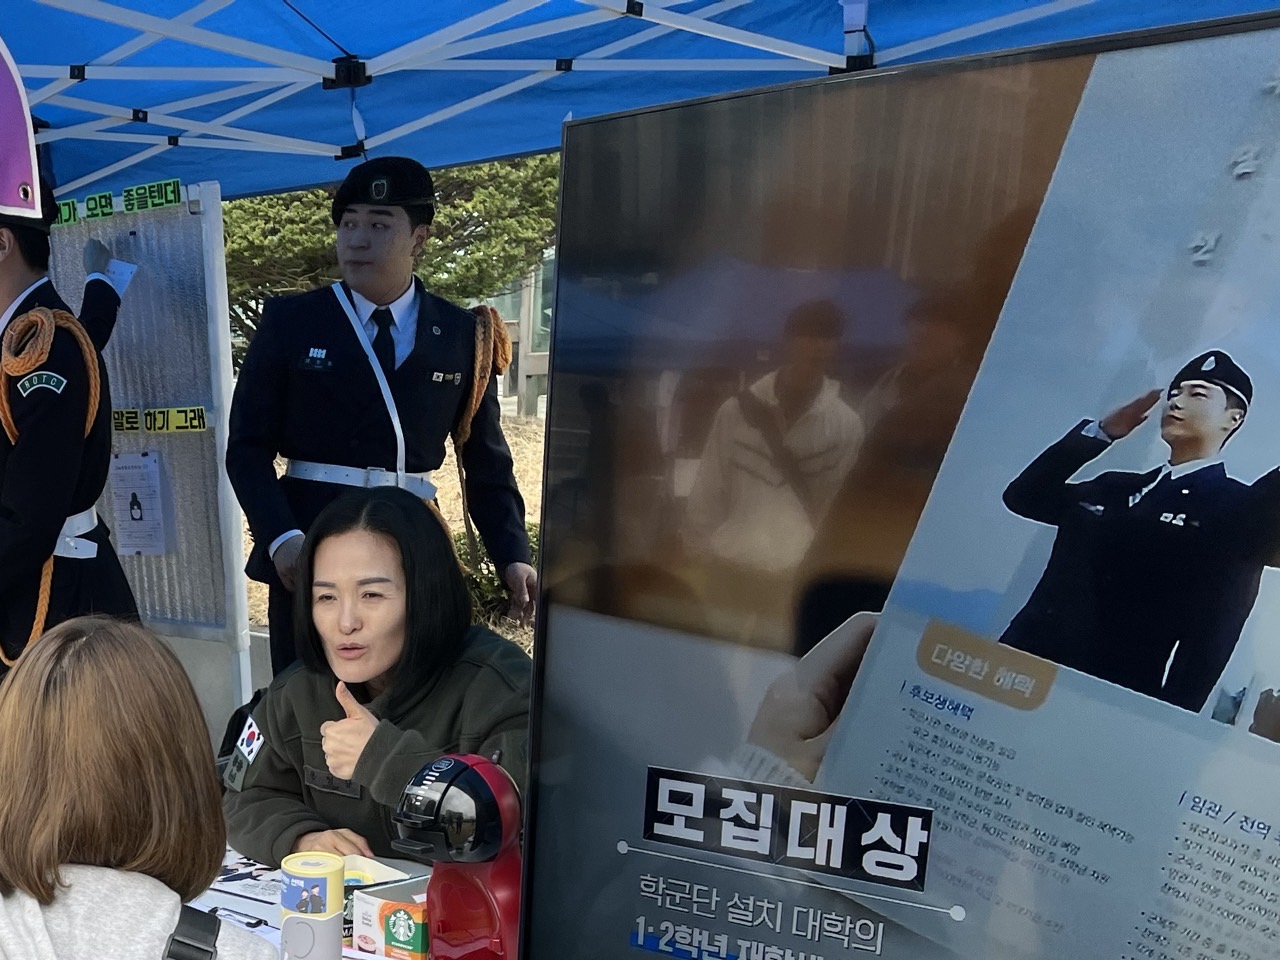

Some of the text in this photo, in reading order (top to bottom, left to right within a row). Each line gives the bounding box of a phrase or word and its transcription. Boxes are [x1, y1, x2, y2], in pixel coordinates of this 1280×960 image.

[86, 194, 113, 219] 오면
[123, 180, 181, 212] 좋을텐데
[24, 373, 58, 390] ROTC
[144, 409, 169, 432] 하기
[1190, 795, 1223, 820] 임관
[653, 777, 929, 882] 모집대상
[639, 873, 885, 956] 학군단 설치 대학의
